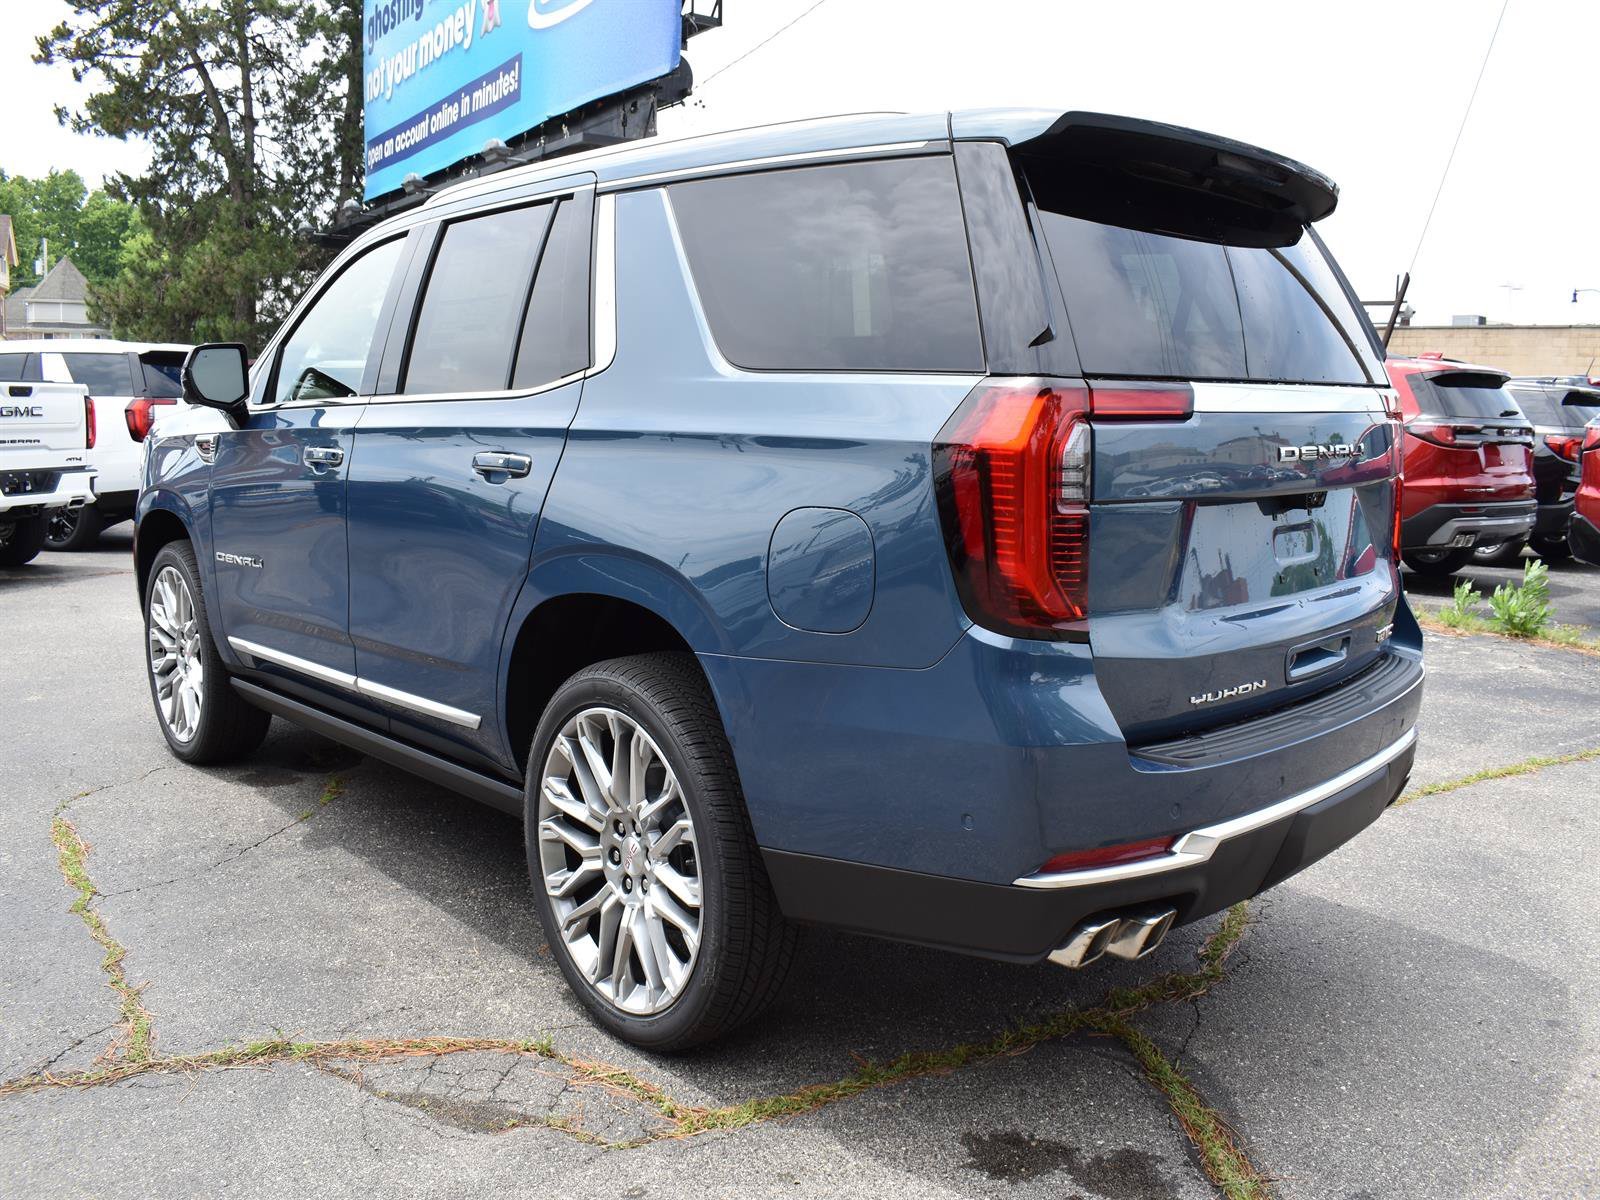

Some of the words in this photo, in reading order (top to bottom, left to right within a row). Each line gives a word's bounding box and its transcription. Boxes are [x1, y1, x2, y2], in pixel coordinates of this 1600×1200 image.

[367, 57, 385, 103] not
[385, 41, 418, 102] your
[418, 0, 477, 71] money
[367, 143, 384, 169] open
[384, 138, 394, 158] an
[395, 113, 430, 153] account
[430, 102, 459, 134] online
[460, 92, 470, 118] in
[472, 61, 519, 113] minutes!
[0, 405, 43, 418] GMC
[1278, 442, 1365, 462] DENALI
[215, 551, 264, 569] DENALI
[1190, 679, 1267, 704] YUKON
